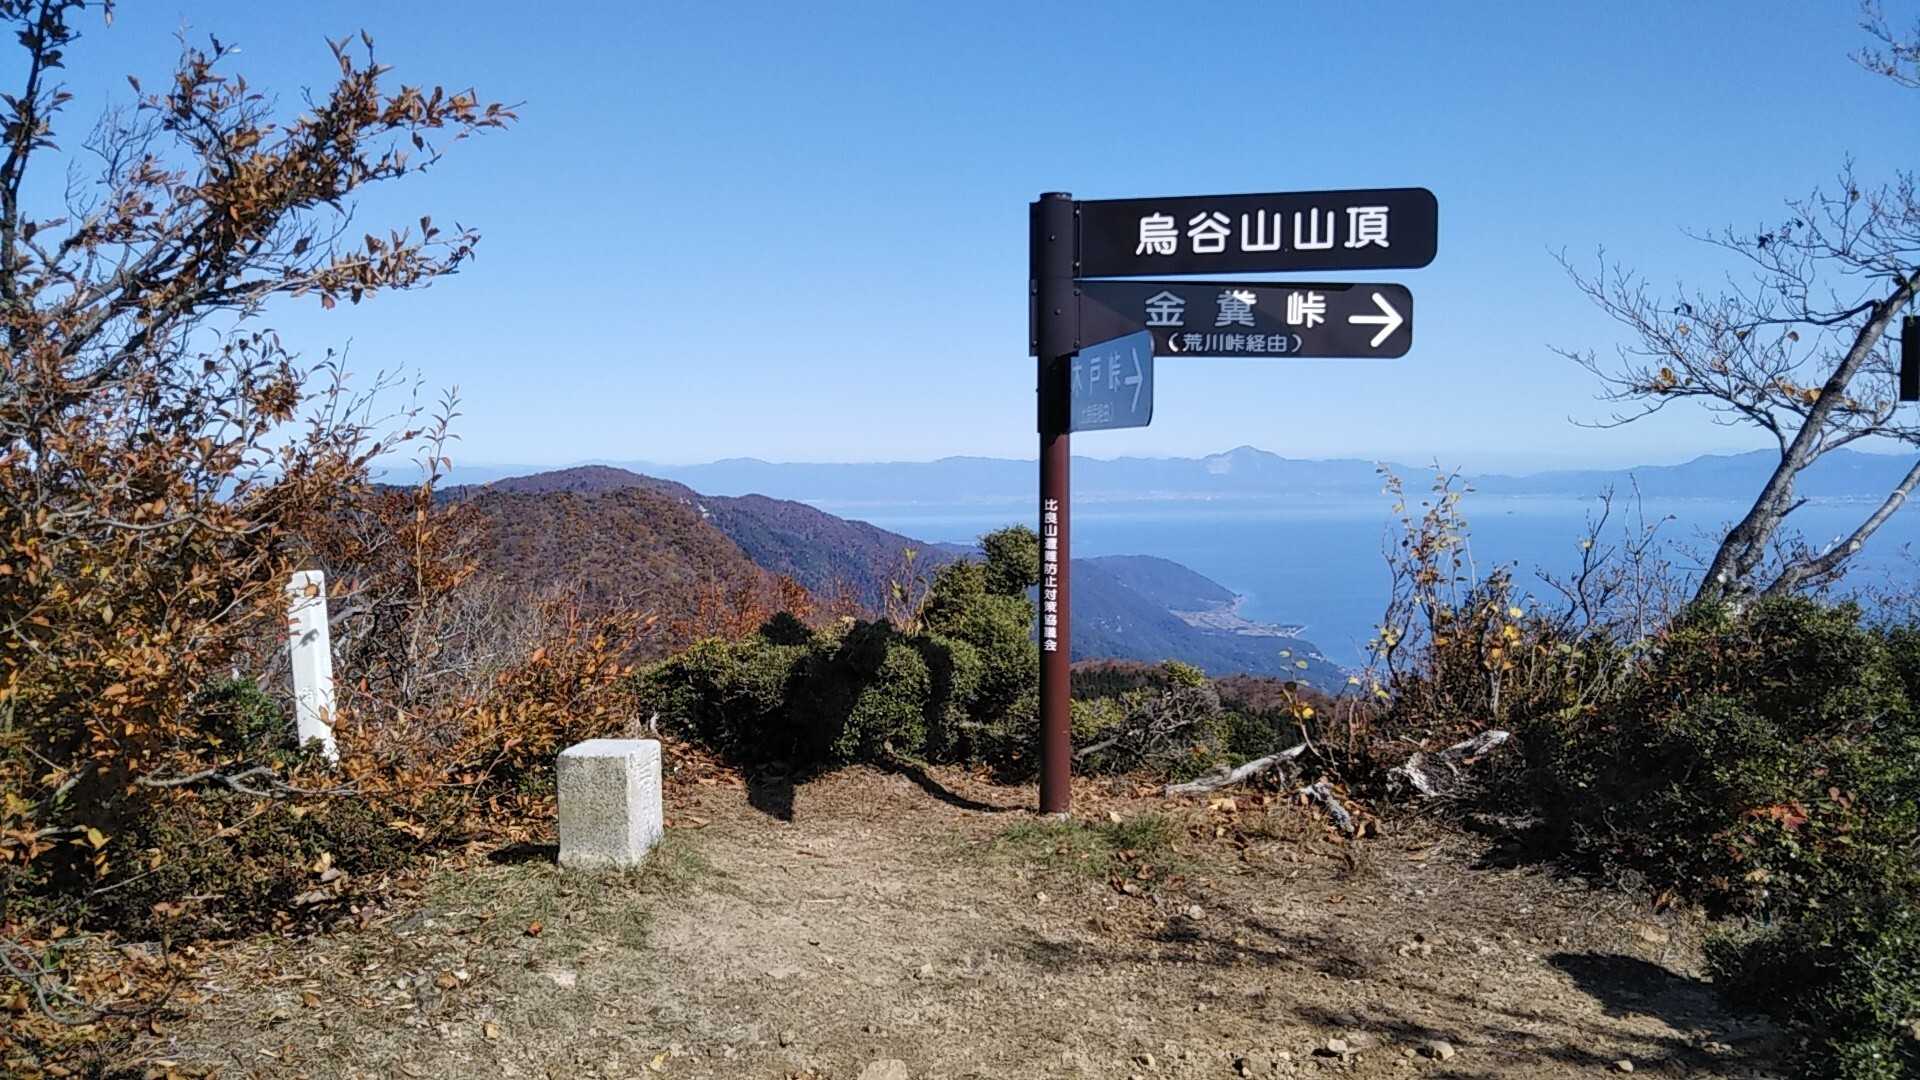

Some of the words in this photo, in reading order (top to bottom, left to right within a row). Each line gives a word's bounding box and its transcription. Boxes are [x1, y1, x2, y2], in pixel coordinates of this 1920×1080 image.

[1136, 207, 1390, 255] 烏谷山山頂
[1145, 291, 1327, 327] 金糞峠
